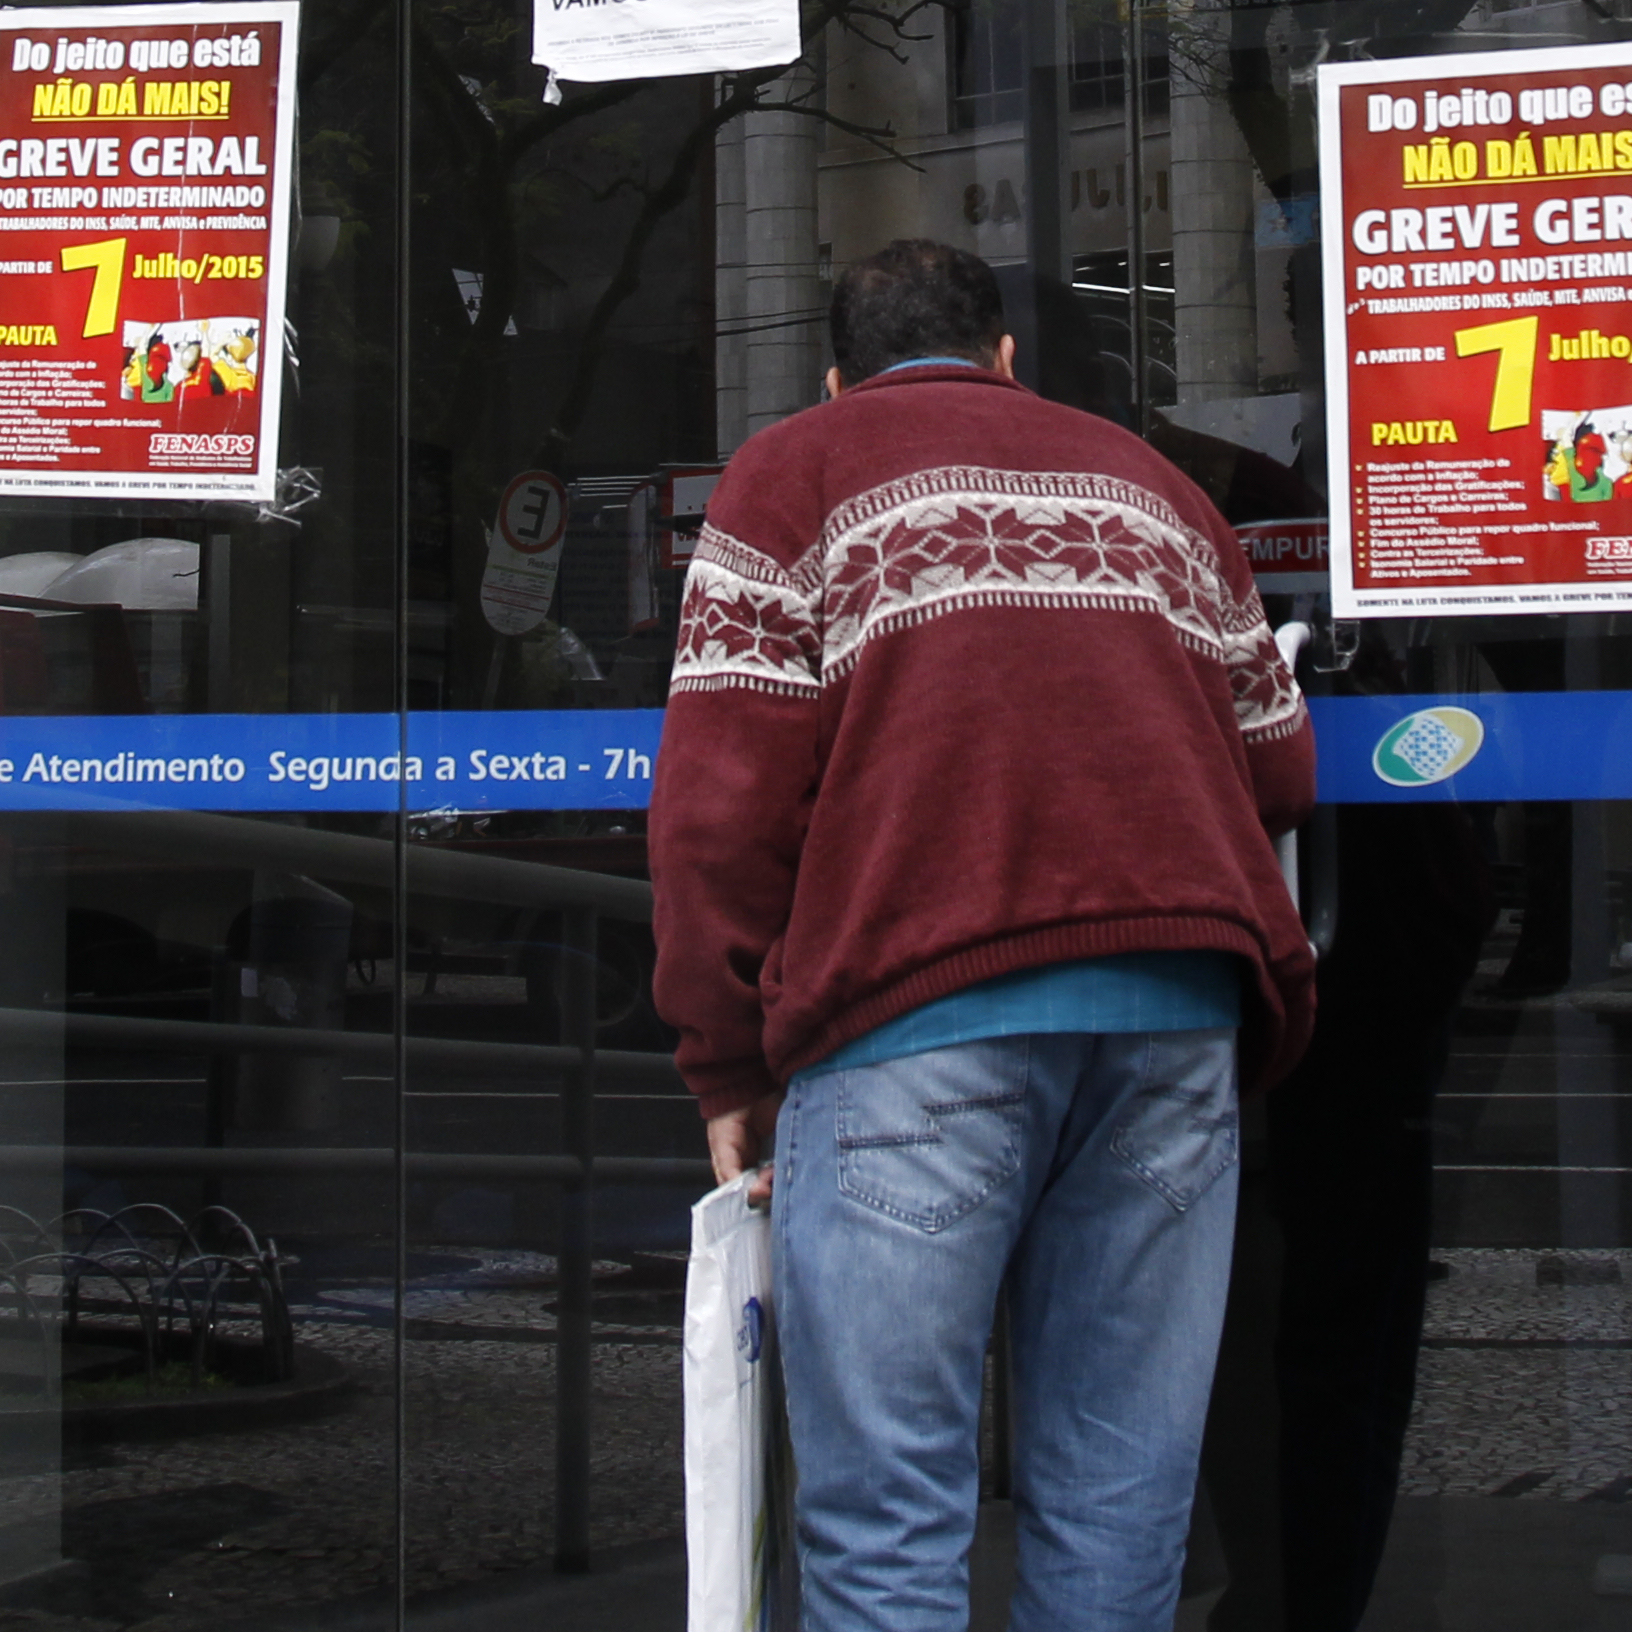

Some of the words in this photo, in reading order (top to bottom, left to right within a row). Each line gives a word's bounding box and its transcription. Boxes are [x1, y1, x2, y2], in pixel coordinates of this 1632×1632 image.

[11, 38, 49, 70] Do
[54, 36, 122, 71] jeito
[128, 39, 186, 69] que
[192, 32, 259, 66] está
[35, 78, 92, 115] NÃO
[99, 77, 139, 114] DÁ
[144, 81, 229, 114] MAIS!
[1368, 92, 1416, 131] Do
[1423, 85, 1511, 130] jeito
[1519, 85, 1592, 124] que
[131, 136, 266, 175] GERAL
[1403, 135, 1477, 182] NÃO
[1486, 131, 1536, 176] DÁ
[33, 188, 97, 207] TEMPO
[102, 186, 264, 207] INDETERMINADO
[1352, 202, 1518, 253] GREVE
[38, 262, 53, 272] DE
[59, 239, 126, 337] 7
[134, 253, 262, 283] Julho/2015
[1357, 265, 1403, 289] POR
[1411, 260, 1494, 286] TEMPO
[1368, 296, 1459, 313] TRABALHADORES
[1464, 295, 1479, 308] DO
[1483, 293, 1510, 309] INSS,
[1514, 288, 1551, 307] SAÚDE,
[1555, 290, 1579, 305] MTE,
[1583, 287, 1624, 302] ANVISA
[1356, 351, 1366, 363] A
[1370, 348, 1420, 363] PARTIR
[1425, 347, 1444, 360] DE
[1455, 317, 1539, 432] 7
[148, 434, 253, 454] FENASPS
[1372, 421, 1456, 444] PAUTA
[22, 752, 245, 783] Atendimento
[268, 750, 423, 791] Segunda
[435, 757, 455, 781] a
[468, 749, 566, 781] Sexta
[603, 748, 651, 780] 7h
